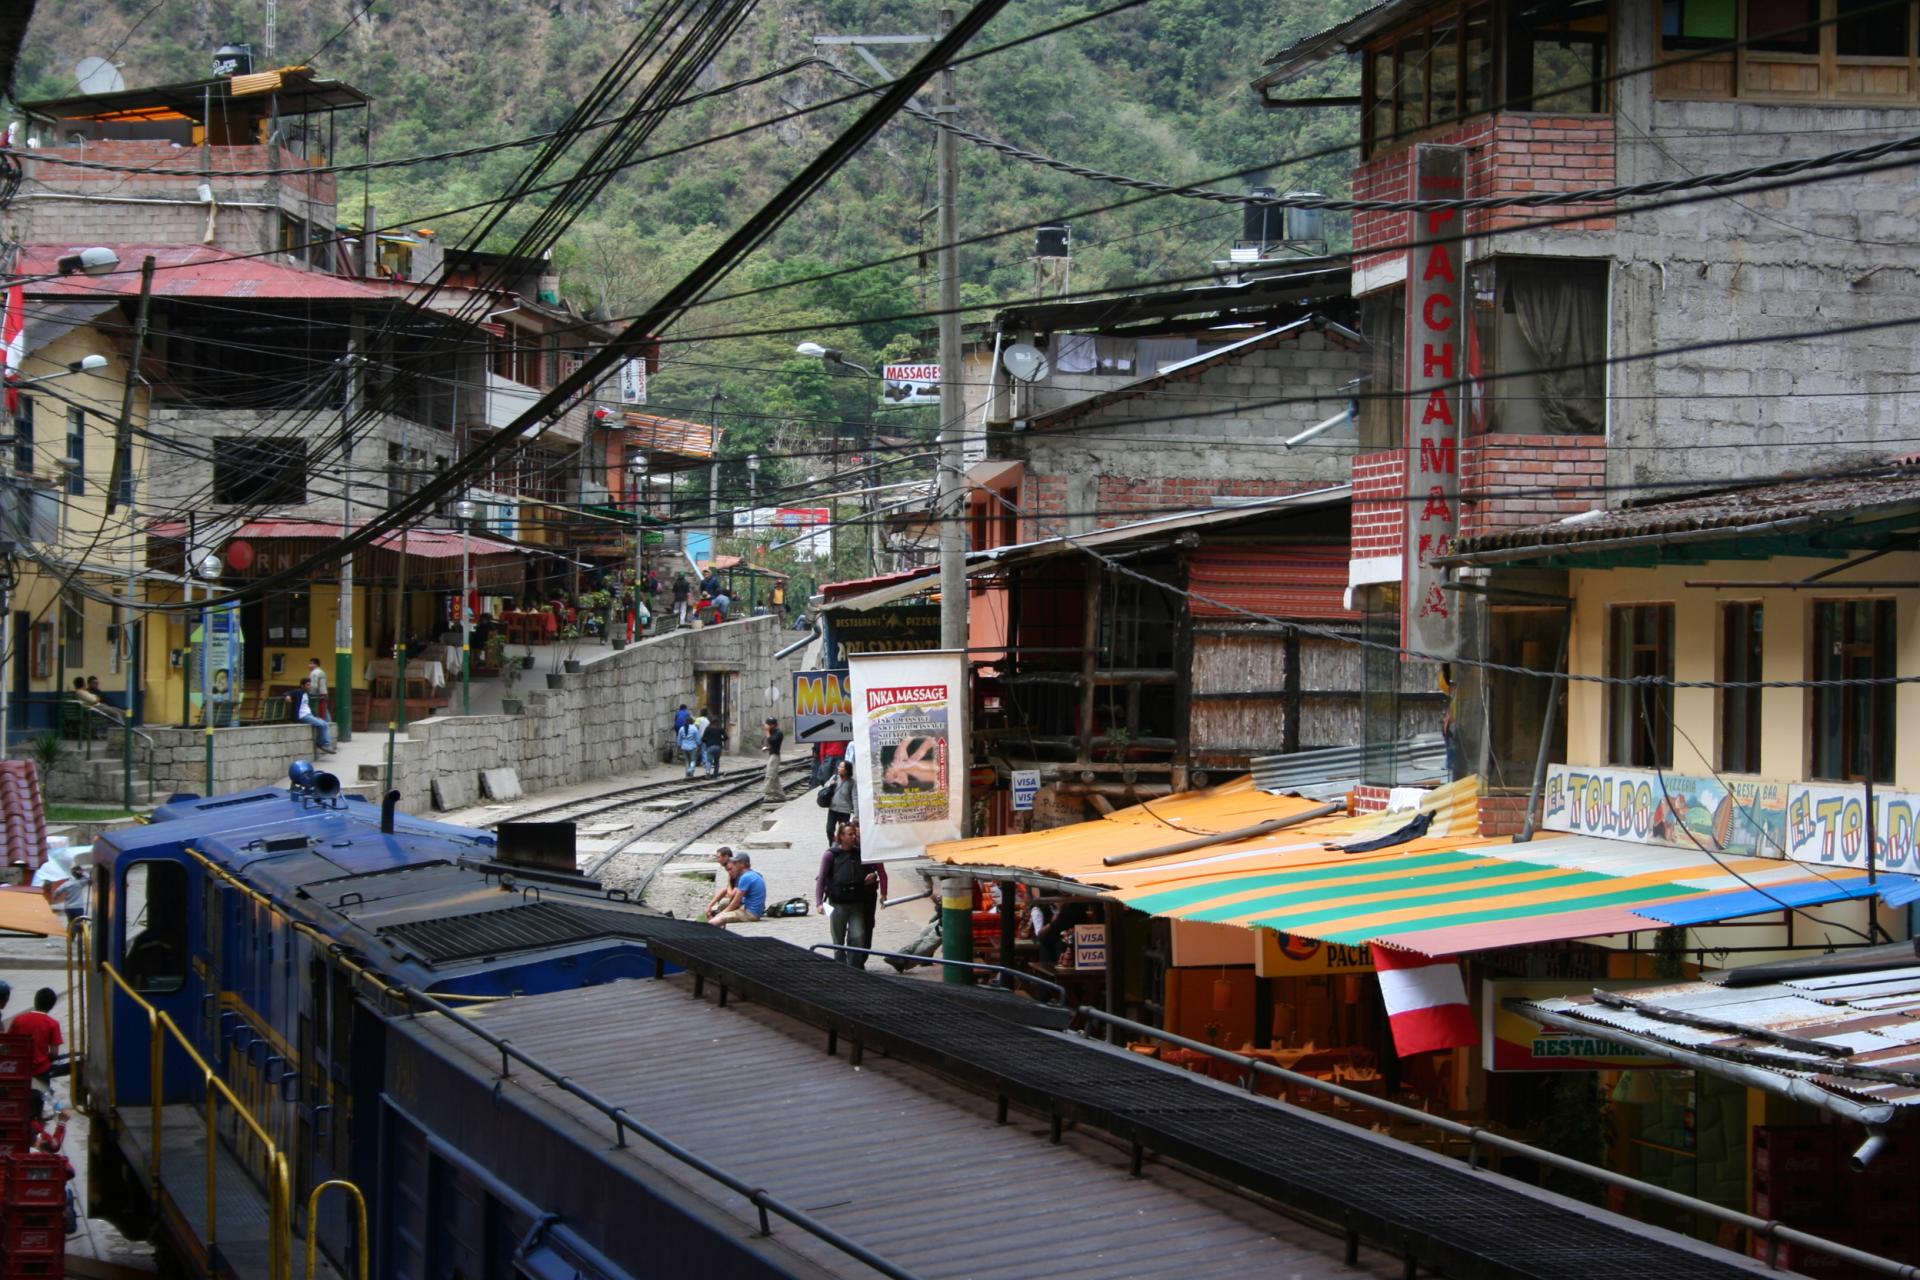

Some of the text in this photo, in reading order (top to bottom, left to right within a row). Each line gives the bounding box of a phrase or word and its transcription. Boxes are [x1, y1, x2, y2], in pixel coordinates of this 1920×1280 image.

[1418, 204, 1457, 619] PACHAMAMA
[869, 688, 945, 709] INKA MASSAGE
[1017, 778, 1037, 786] VISA
[1664, 777, 1696, 793] PIZZERIA
[1762, 784, 1778, 801] BAR
[1018, 793, 1035, 802] VIS
[1546, 773, 1652, 839] EL TOLDO
[1790, 790, 1817, 853] EL
[1080, 933, 1104, 942] VISA
[1081, 951, 1104, 960] VISA
